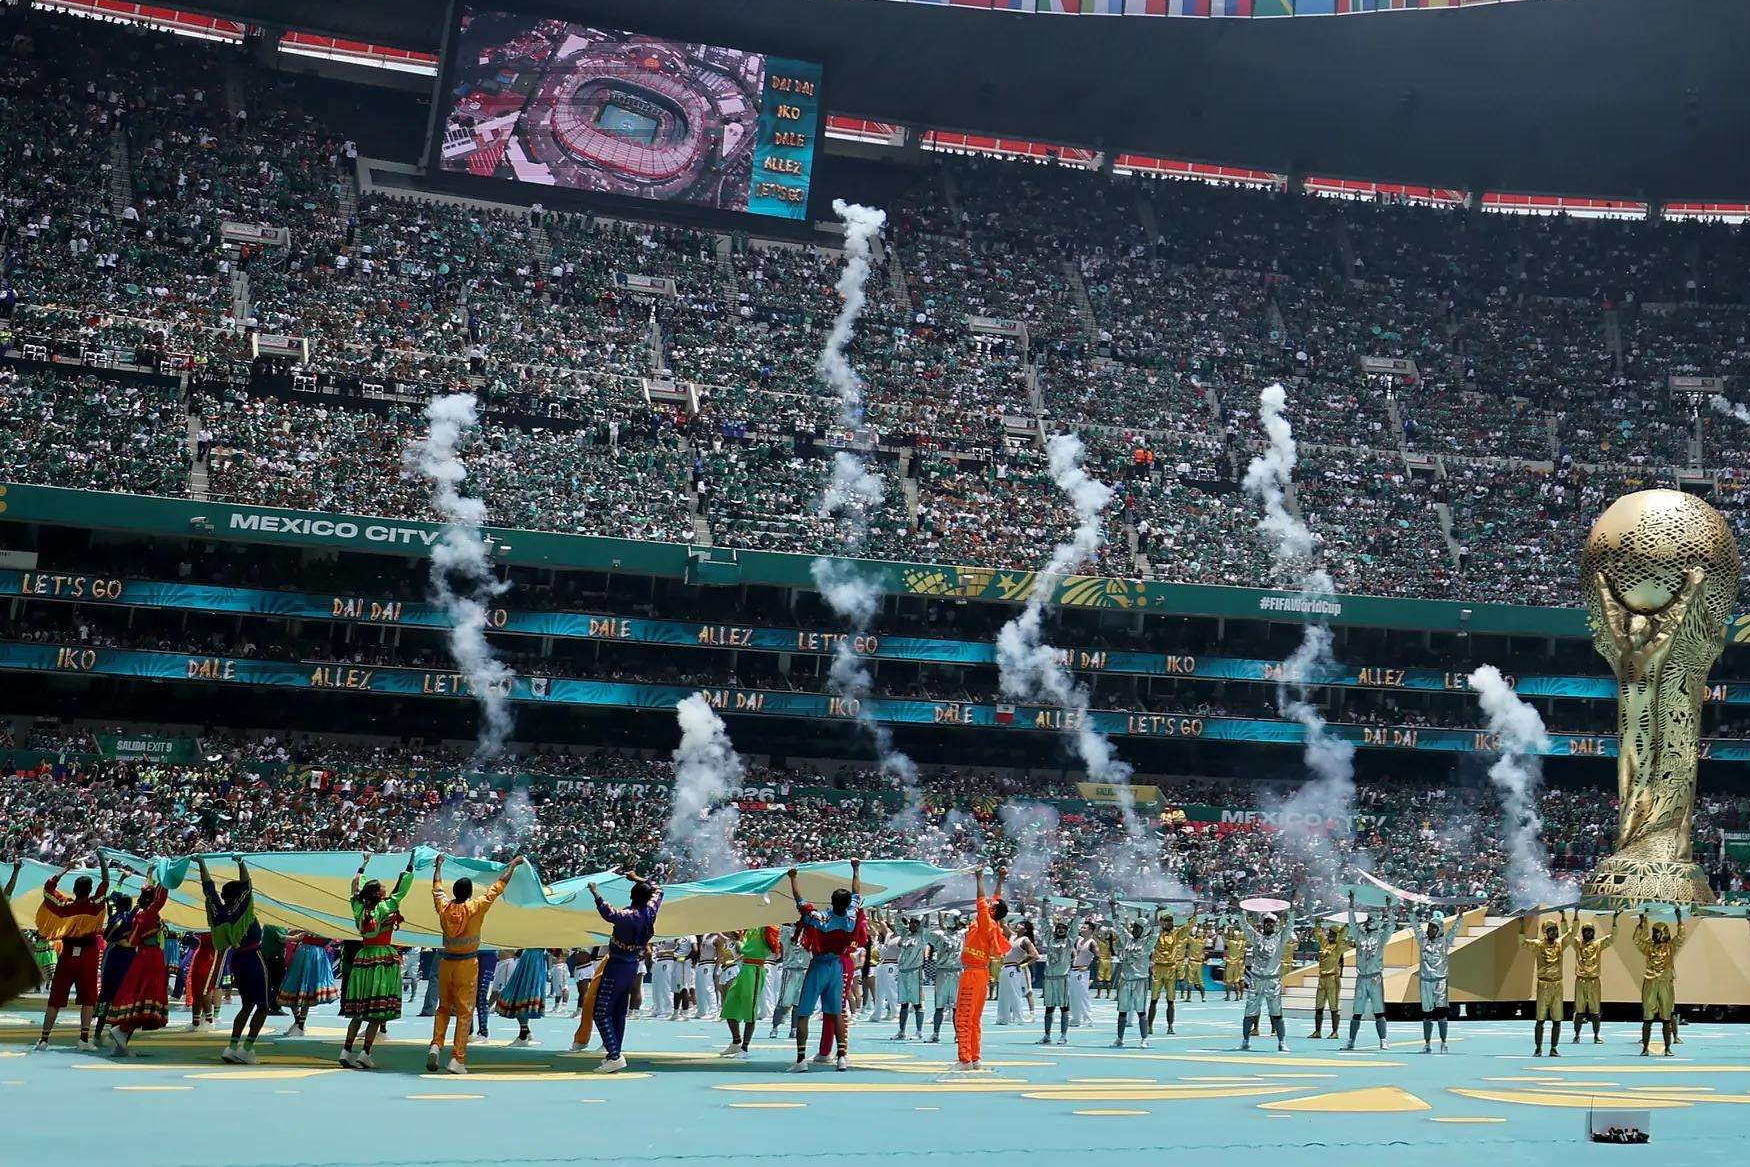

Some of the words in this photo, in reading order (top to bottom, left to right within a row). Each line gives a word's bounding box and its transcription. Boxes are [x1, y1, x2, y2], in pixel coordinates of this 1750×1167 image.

[777, 104, 801, 120] IKO
[763, 155, 802, 174] ALLEZ
[229, 513, 358, 538] MEXICO
[365, 525, 440, 546] CITY
[22, 573, 86, 598] LET'S
[92, 579, 122, 600] GO
[332, 597, 364, 618] DAI
[370, 601, 402, 621] DAI
[1259, 596, 1342, 617] #FIFAWorldCup
[480, 608, 508, 628] KO
[588, 617, 632, 638] DALE
[699, 625, 754, 647] ALLEZ
[853, 635, 878, 654] GO
[57, 647, 96, 670] IKO
[188, 658, 236, 679] DALE
[1080, 651, 1107, 670] DAI
[1166, 655, 1195, 675] IKO
[311, 666, 373, 690] ALLEZ
[1358, 667, 1405, 686] ALLEZ
[703, 689, 729, 709] DAI
[736, 692, 764, 712] DAI
[1703, 685, 1728, 702] DAI
[829, 698, 860, 716] IKO
[934, 704, 973, 724] DALE
[1128, 715, 1176, 735] LET'S
[1181, 718, 1203, 736] GO
[116, 740, 146, 752] SALIDA
[146, 741, 166, 752] EXIT
[166, 742, 173, 753] 9
[1363, 727, 1387, 745] DAI
[1394, 729, 1418, 747] DAI
[1569, 738, 1606, 755] DALE
[1221, 810, 1322, 827] MEXICO
